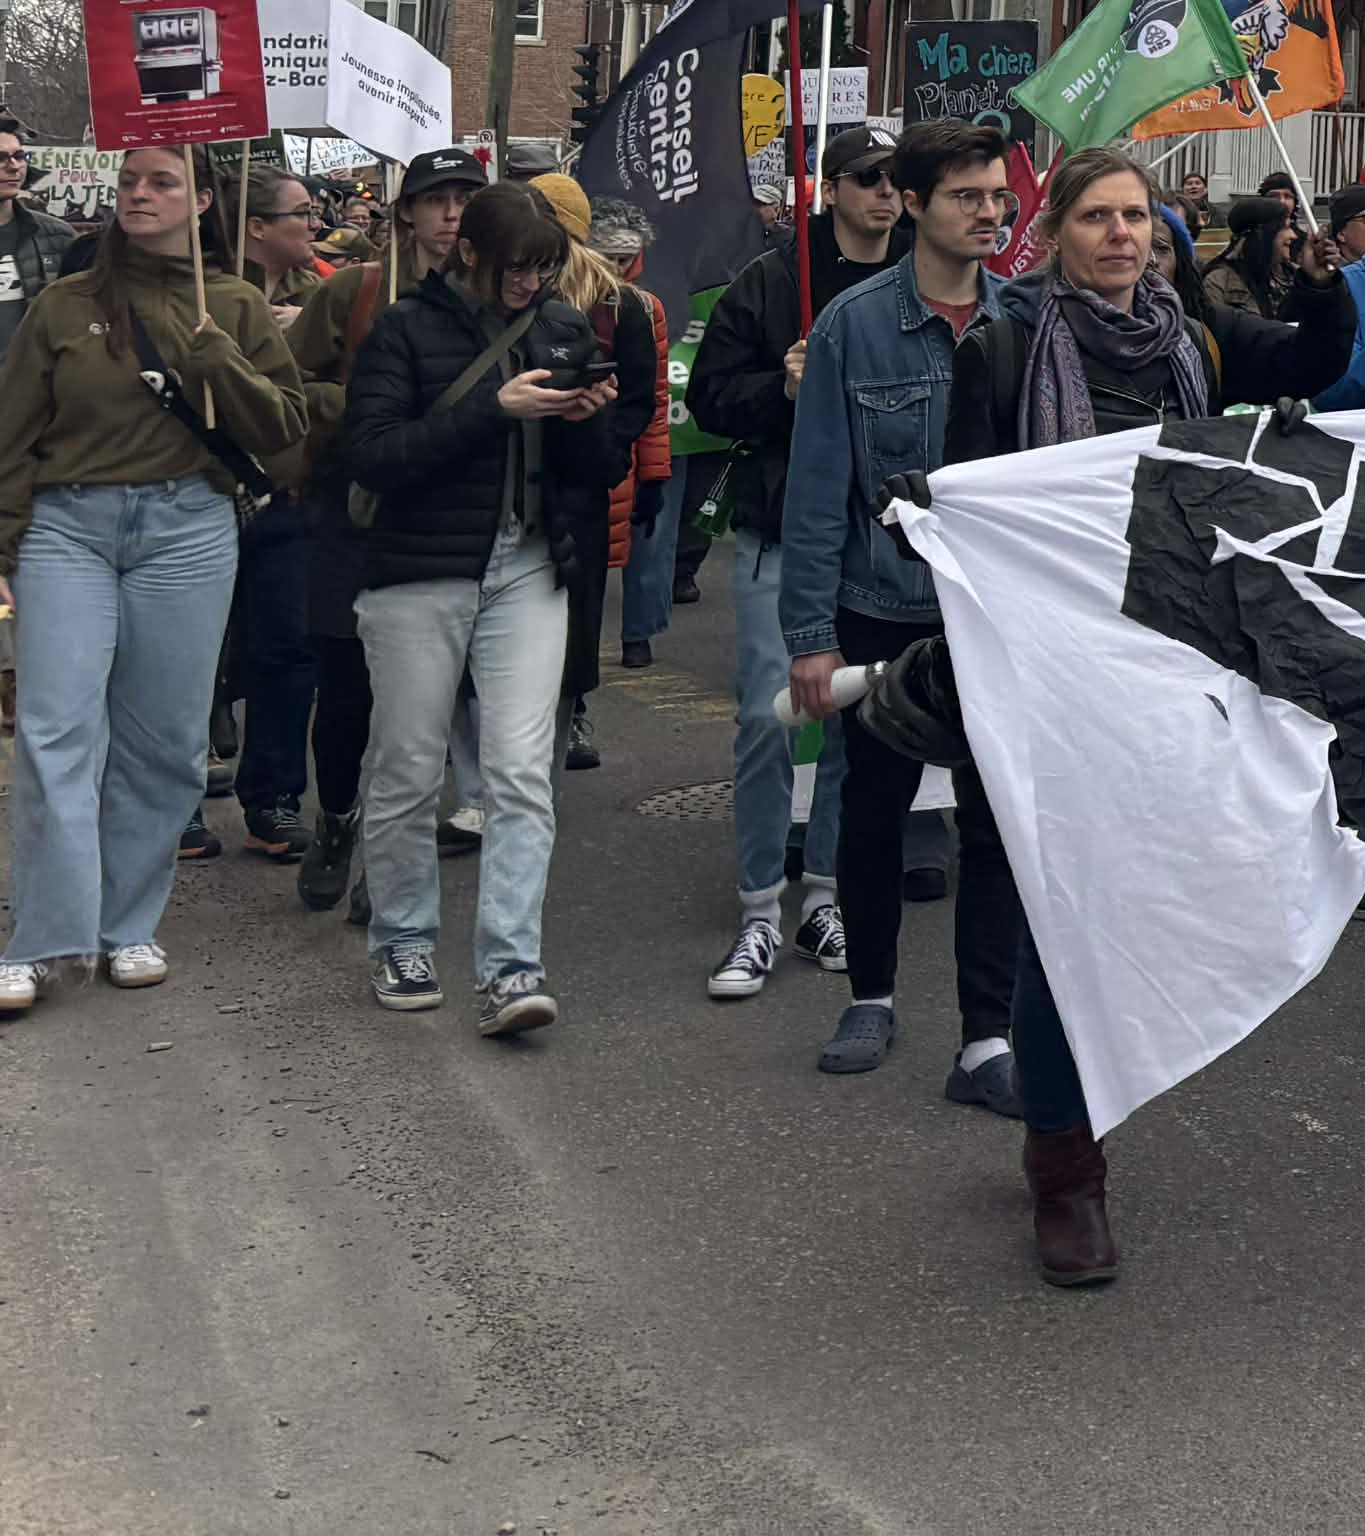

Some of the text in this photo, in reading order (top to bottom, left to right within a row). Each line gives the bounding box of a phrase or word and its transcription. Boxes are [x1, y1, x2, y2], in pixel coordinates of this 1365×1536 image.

[341, 52, 396, 88] Jeunesse
[916, 32, 968, 81] Ma
[650, 59, 675, 202] central
[672, 47, 700, 204] Conseil
